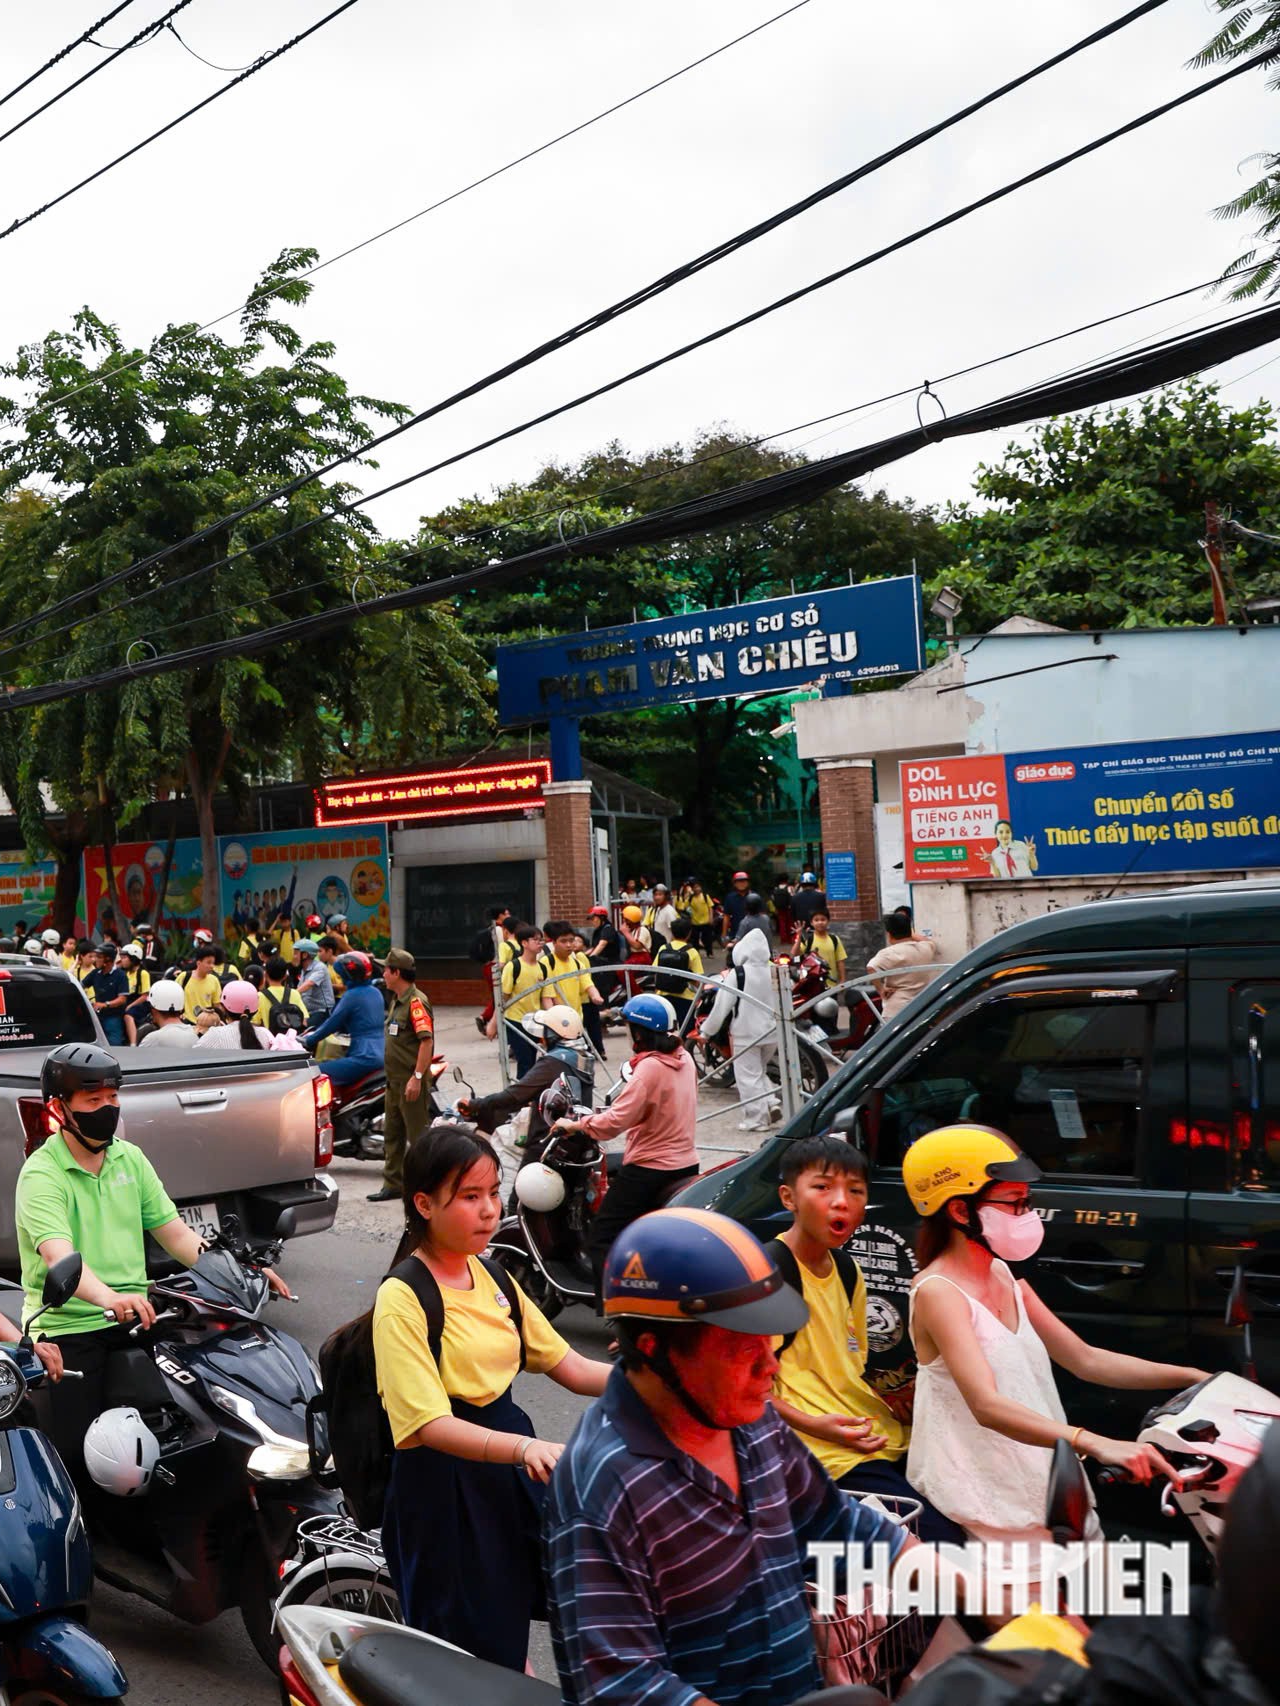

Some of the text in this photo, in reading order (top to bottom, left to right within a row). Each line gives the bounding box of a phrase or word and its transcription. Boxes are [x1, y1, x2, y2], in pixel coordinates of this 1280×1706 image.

[708, 620, 750, 643] HỌC
[755, 611, 784, 632] CƠ
[791, 602, 819, 626] SỞ
[649, 649, 725, 688] VĂN
[857, 664, 899, 675] 62954013
[1082, 761, 1100, 770] TẠP
[1121, 757, 1143, 766] GIÁO
[1146, 756, 1167, 765] DỤC
[1169, 753, 1202, 762] THÀNH
[1205, 749, 1226, 759] PHỐ
[1229, 747, 1244, 757] HỒ
[1247, 747, 1265, 755] CHÍ
[908, 766, 946, 783] DOL
[1016, 765, 1046, 781] giáo
[908, 781, 997, 802] ĐÌNH LỰC
[1094, 787, 1235, 816] Chuyển đổi số
[916, 808, 993, 823] TIẾNG ANH
[917, 824, 981, 839] CẤP 1 & 2
[1045, 824, 1090, 846] Thúc
[1094, 821, 1128, 844] đẩy
[1133, 822, 1170, 846] học
[1173, 820, 1208, 843] tập
[1212, 814, 1260, 838] suốt
[874, 1225, 906, 1246] NAM
